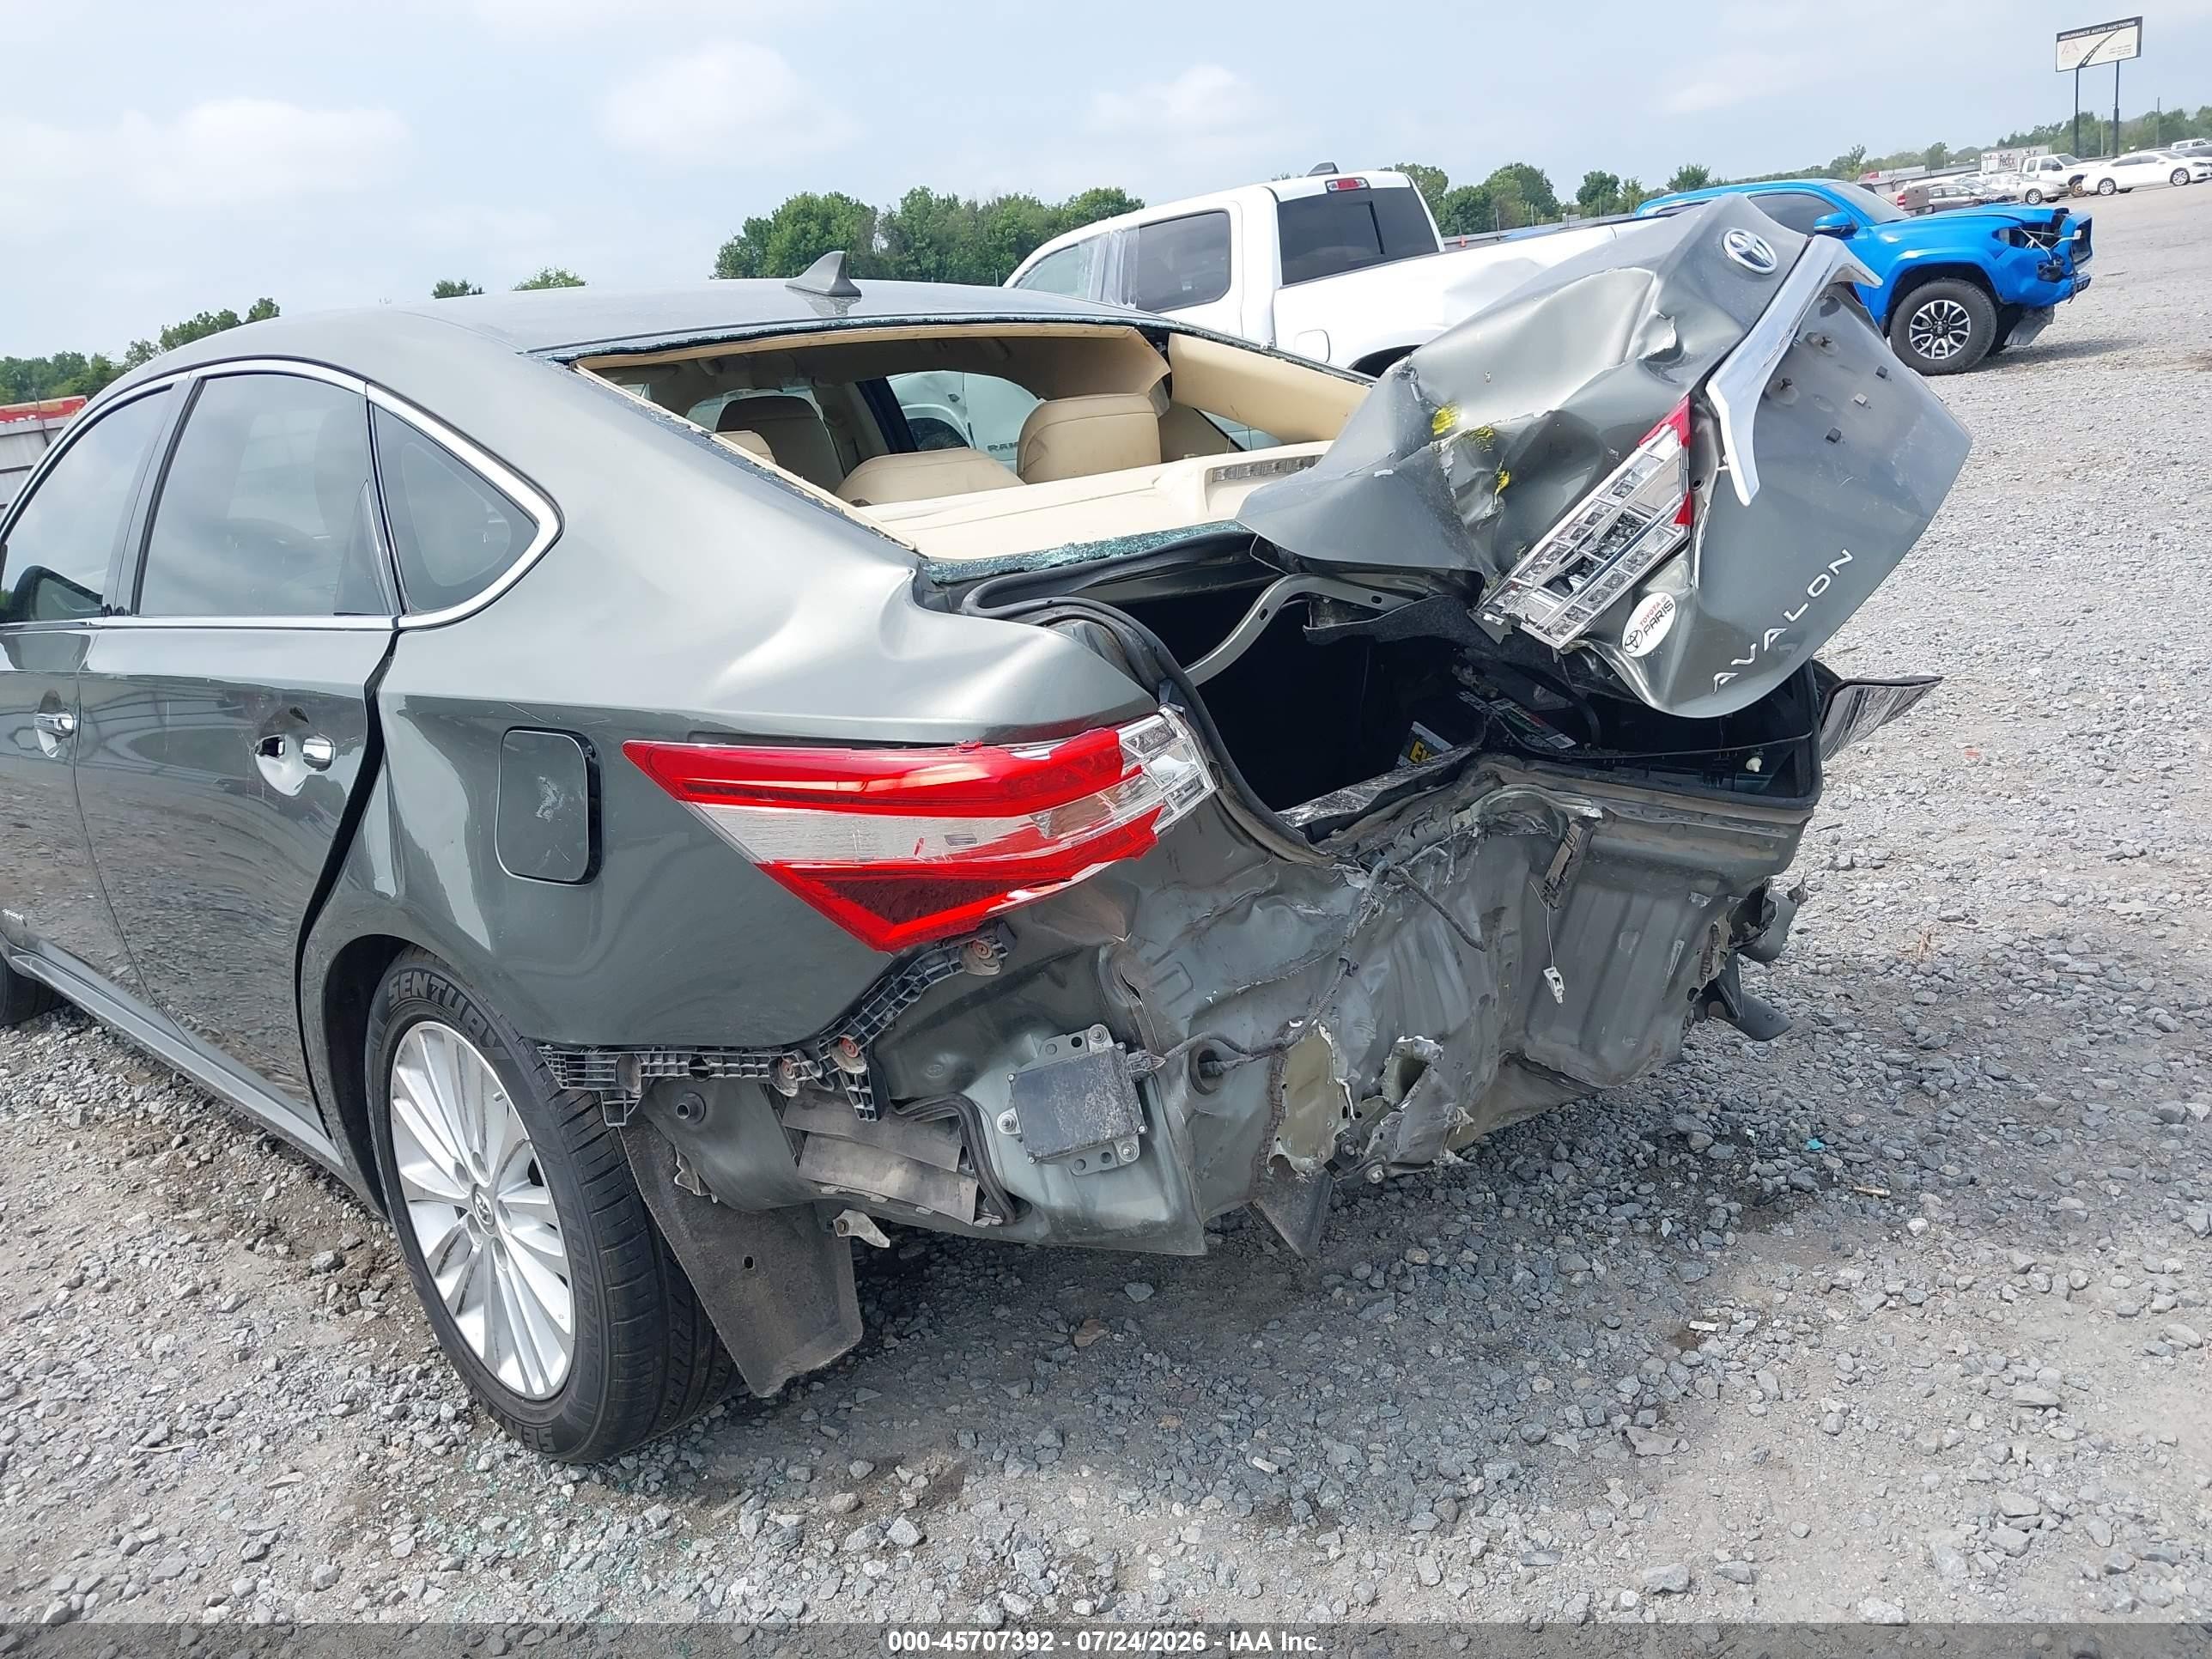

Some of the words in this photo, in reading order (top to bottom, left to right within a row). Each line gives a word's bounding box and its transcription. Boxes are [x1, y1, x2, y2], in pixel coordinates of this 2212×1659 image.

[2059, 29, 2090, 40] INSURANCE
[2091, 26, 2106, 34] AUTO
[2106, 20, 2136, 31] AUCTIONS
[1639, 601, 1662, 627] TOYOTA
[1643, 599, 1674, 636] PARIS
[1711, 548, 1854, 695] AVALON
